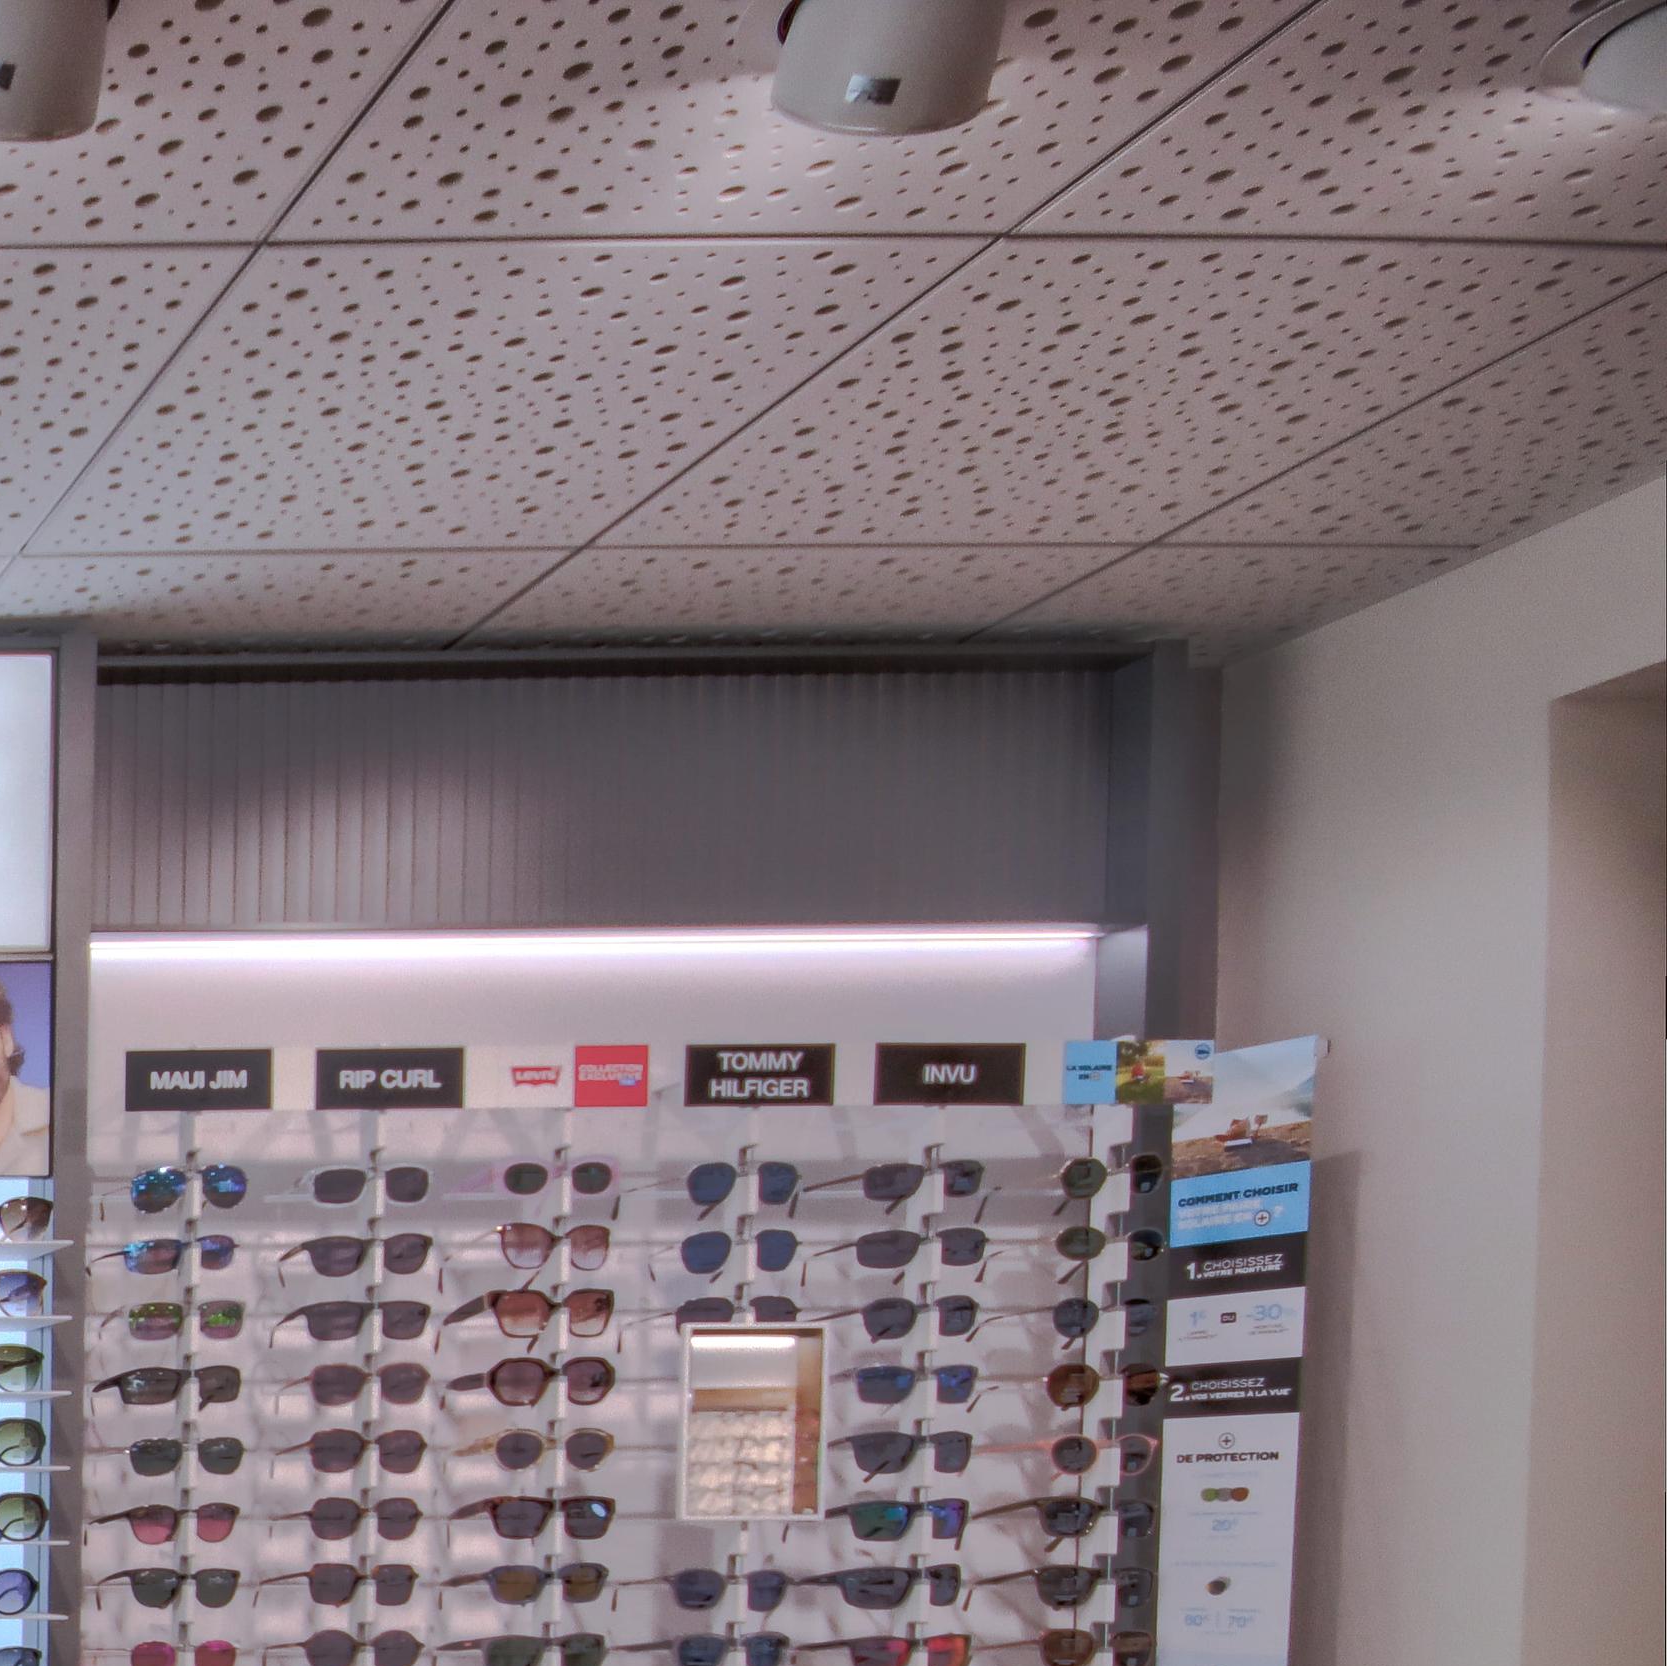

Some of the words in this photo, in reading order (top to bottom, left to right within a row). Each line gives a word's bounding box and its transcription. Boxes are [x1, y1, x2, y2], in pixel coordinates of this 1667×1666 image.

[717, 1051, 804, 1072] TOMMY
[150, 1070, 205, 1090] MAUI
[209, 1069, 247, 1089] JIM
[339, 1070, 376, 1090] RIP
[380, 1069, 442, 1089] CURL
[922, 1064, 977, 1084] INVU
[709, 1078, 810, 1098] HILFIGER
[1177, 1190, 1240, 1208] COMMENT
[1243, 1182, 1299, 1198] CHOISIR
[1186, 1262, 1203, 1280] 1.
[1203, 1253, 1284, 1272] CHOISISSEZ
[1170, 1383, 1190, 1402] 2.
[1191, 1377, 1265, 1391] CHOISISSEZ
[1176, 1453, 1193, 1463] DE
[1196, 1451, 1279, 1462] PROTECTION
